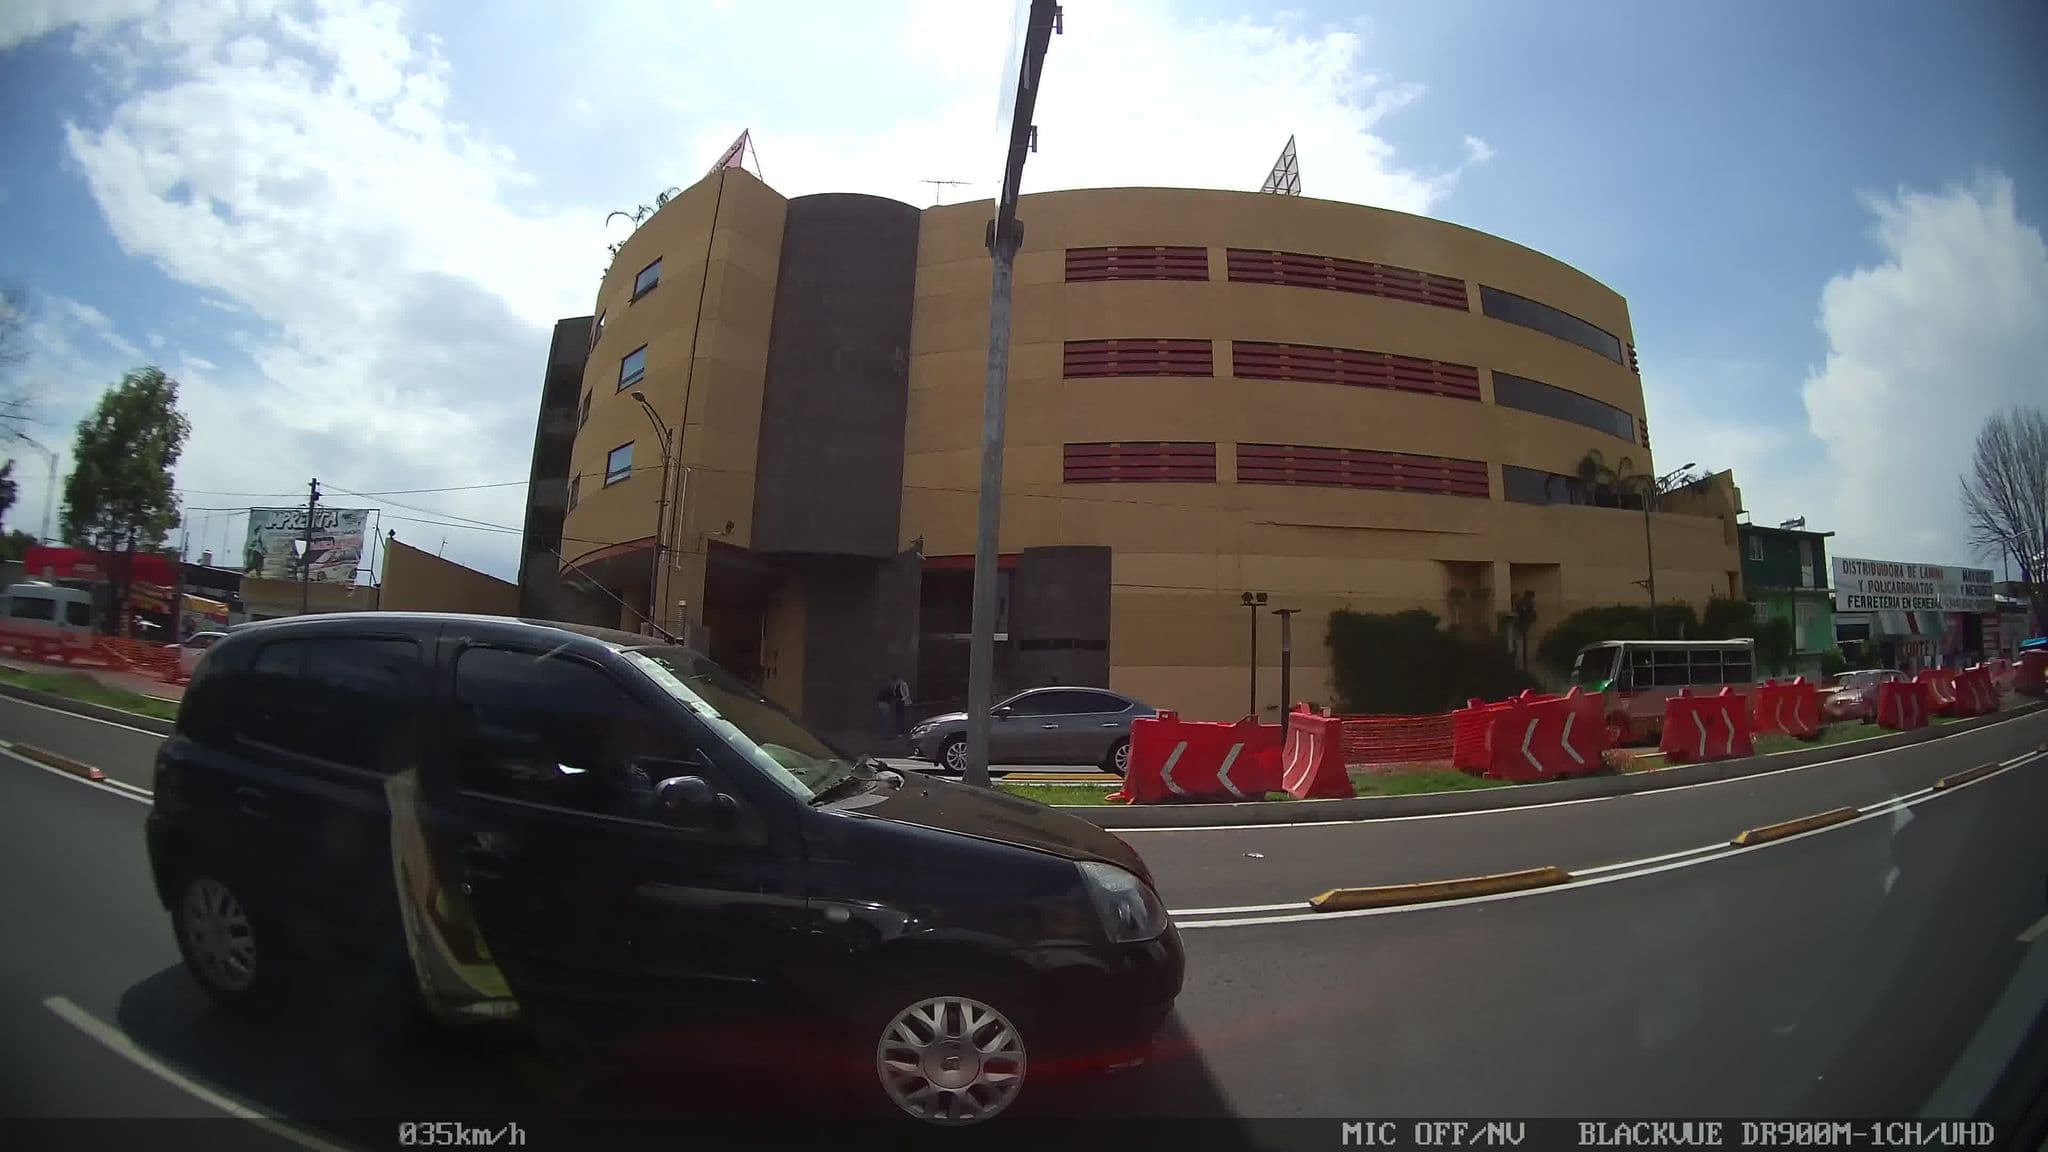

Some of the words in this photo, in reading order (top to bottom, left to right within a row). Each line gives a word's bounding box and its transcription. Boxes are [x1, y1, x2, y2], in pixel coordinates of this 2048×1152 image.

[1842, 560, 1904, 578] DISTRIBUIDORA
[1908, 565, 1917, 578] DE
[1858, 580, 1864, 593] Y
[1868, 580, 1934, 594] POLICARBONATOS
[1847, 595, 1901, 609] FERRETERIA
[1902, 595, 1912, 609] EN
